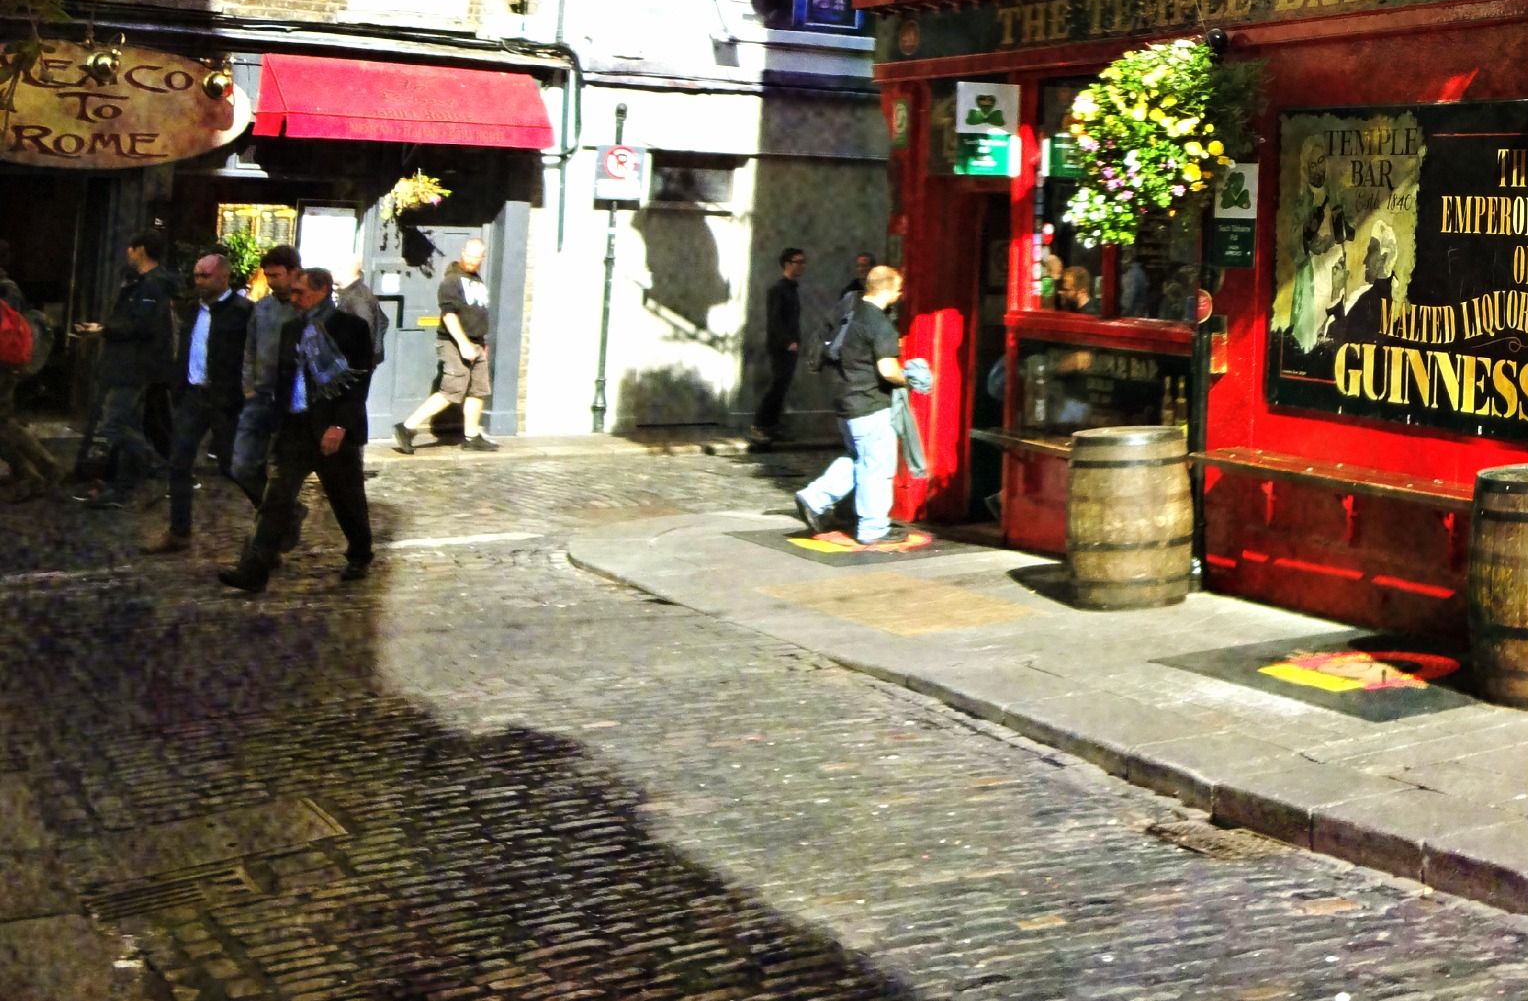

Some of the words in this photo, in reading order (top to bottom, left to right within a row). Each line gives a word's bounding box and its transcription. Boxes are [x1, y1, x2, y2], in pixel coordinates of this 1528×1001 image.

[11, 125, 169, 159] ROME
[1323, 127, 1418, 157] TEMPLE
[1350, 159, 1395, 191] BAR
[1379, 297, 1456, 345] MALTED
